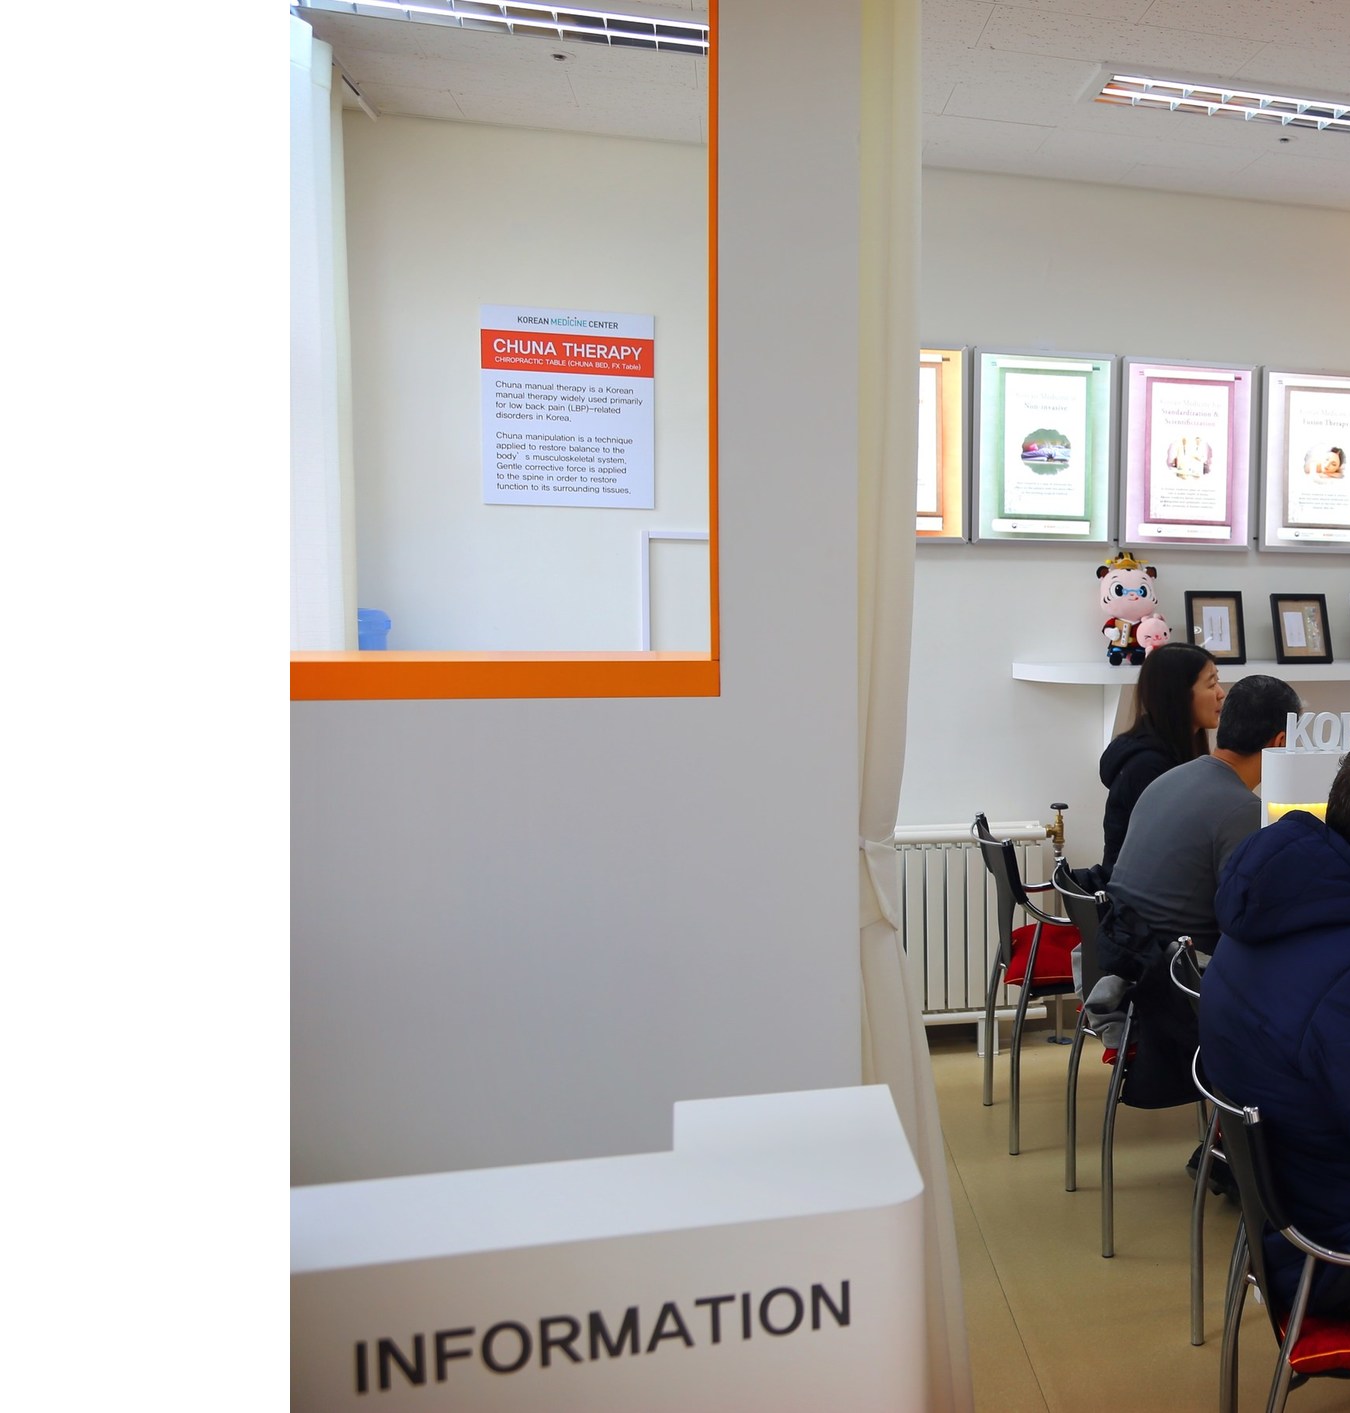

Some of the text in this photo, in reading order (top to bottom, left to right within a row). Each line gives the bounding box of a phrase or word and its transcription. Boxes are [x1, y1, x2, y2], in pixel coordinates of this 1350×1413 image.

[517, 316, 549, 325] KOREAN
[589, 321, 618, 329] CENTER
[493, 338, 642, 360] CHUNA THERAPY
[495, 356, 543, 365] CHIROPRACTIC
[568, 360, 593, 368] (CHUNA
[556, 384, 586, 393] therapy
[528, 393, 558, 401] therapy
[610, 398, 643, 406] primarily
[496, 412, 533, 420] disorders
[526, 433, 575, 442] manipulation
[595, 436, 633, 445] technique
[496, 442, 526, 451] applied
[533, 454, 594, 463] musculoskeletal
[553, 485, 599, 494] surrounding
[354, 1279, 852, 1395] INFORMATION
